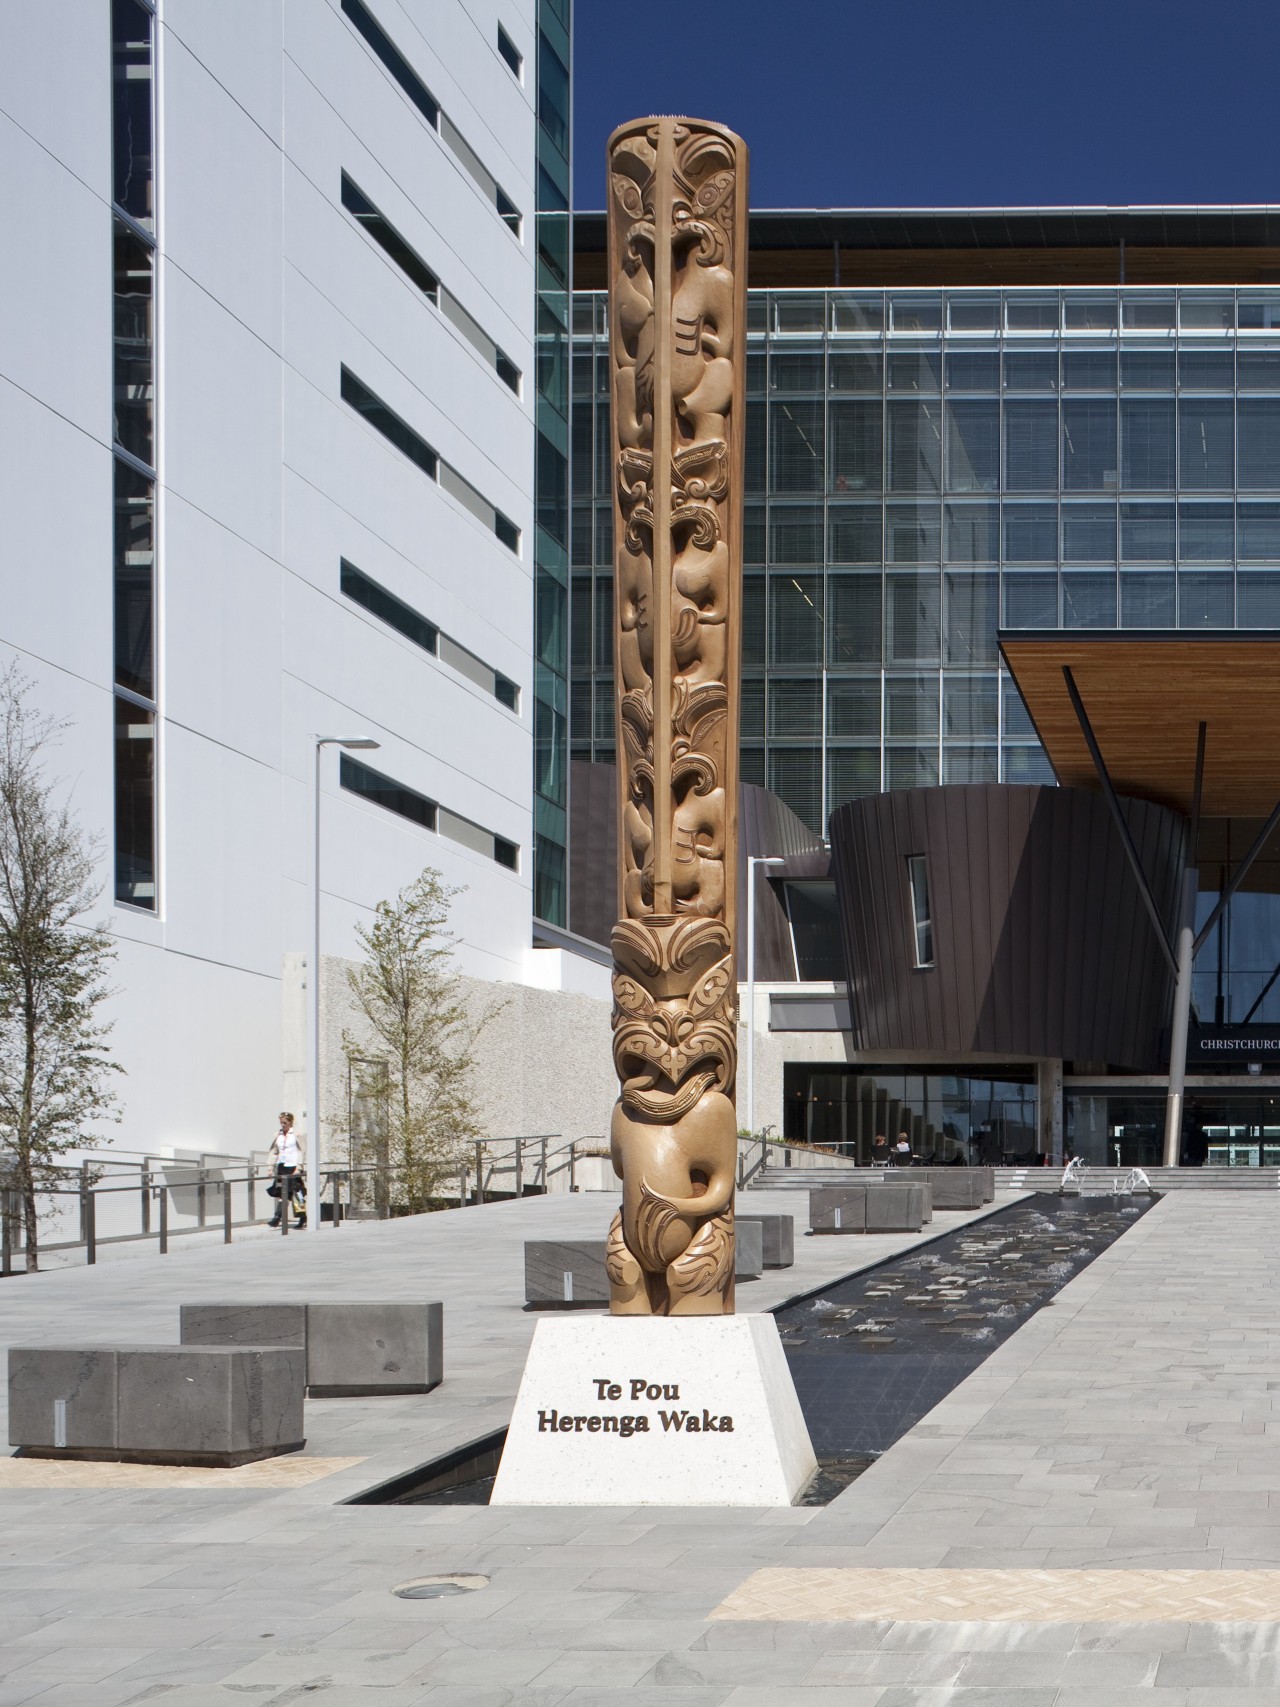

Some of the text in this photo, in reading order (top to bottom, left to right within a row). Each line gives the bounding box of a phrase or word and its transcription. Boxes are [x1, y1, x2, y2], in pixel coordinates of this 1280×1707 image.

[593, 1379, 680, 1400] Te Pou
[537, 1409, 735, 1438] Herenga Waka
